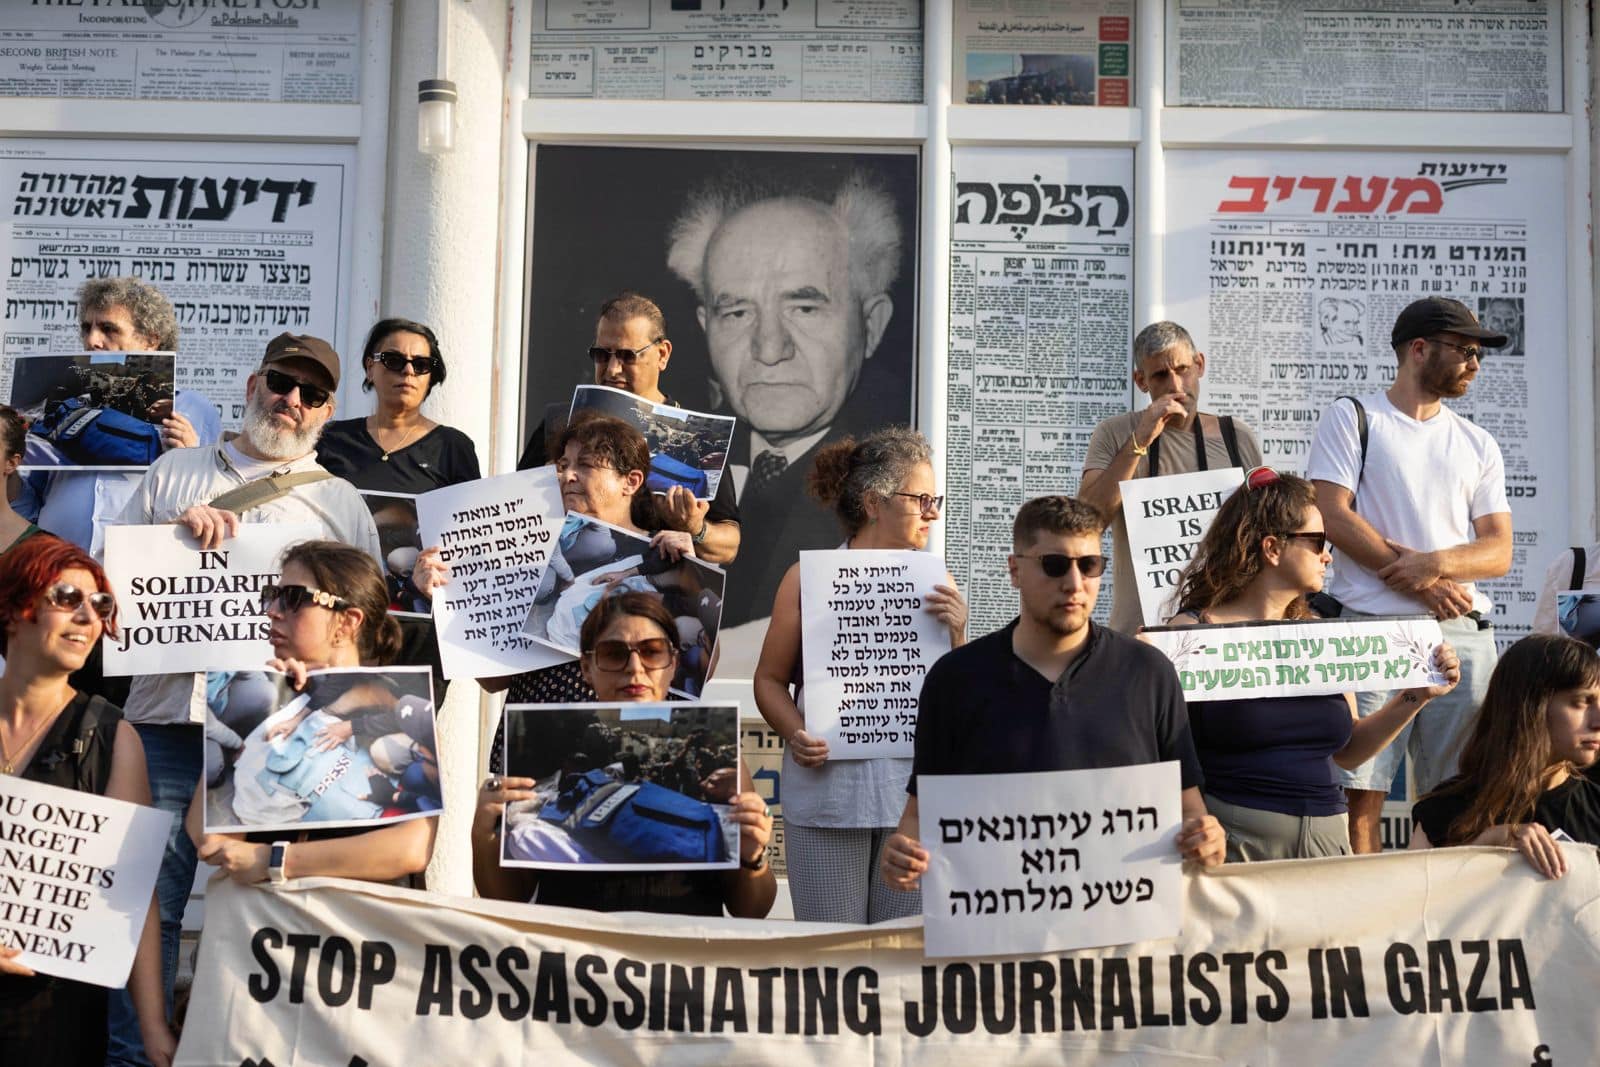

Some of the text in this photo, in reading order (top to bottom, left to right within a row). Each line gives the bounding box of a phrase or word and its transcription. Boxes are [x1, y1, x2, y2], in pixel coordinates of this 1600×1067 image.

[1353, 15, 1391, 29] העליה
[1447, 18, 1465, 30] את
[1469, 18, 1505, 30] אשרה
[1509, 18, 1548, 30] הכנסת
[46, 48, 86, 58] BRITISH
[89, 48, 119, 58] NOTE
[693, 45, 773, 62] מברקים
[1417, 161, 1508, 178] ידיעות
[20, 171, 127, 195] מהדורה
[123, 174, 318, 224] ידיעות
[1217, 175, 1444, 215] מעריב
[13, 195, 120, 219] ראשונה
[1210, 239, 1527, 262] המנדט מת! תחי מדינתנו!
[11, 256, 70, 279] גשרים
[131, 259, 176, 281] בתים
[186, 261, 249, 283] עשרות
[259, 263, 312, 284] פוצצו
[1209, 258, 1367, 275] ממשלת מדינת ישראל
[1371, 263, 1419, 277] האחרון
[1487, 264, 1527, 279] הנציב
[1209, 275, 1260, 290] השלטון
[1282, 275, 1315, 290] לידה
[1320, 275, 1367, 291] מקבלת
[1371, 278, 1409, 293] הארץ
[1470, 280, 1490, 295] את
[200, 303, 250, 325] מוכנה
[254, 305, 311, 327] הועדה
[1353, 363, 1368, 380] על
[452, 504, 501, 524] צוואתי
[1142, 491, 1223, 518] ISRAEL
[440, 514, 543, 547] והמסר האחרון
[1179, 517, 1202, 538] IS
[439, 530, 551, 562] שלי. אם המילים
[1144, 542, 1199, 566] TRY
[199, 551, 229, 570] IN
[451, 549, 546, 578] האלה מגיעות
[462, 567, 540, 593] אליכם, דעו
[838, 565, 908, 579] "חייתי את
[131, 574, 281, 596] SOLIDARIT
[833, 581, 915, 595] הכאב על כל
[136, 600, 213, 620] WITH
[444, 592, 502, 611] הצליחה
[828, 599, 921, 613] פרטיו, טעמתי
[468, 608, 503, 623] אותי
[838, 612, 912, 630] סבל ואובדן
[118, 622, 272, 652] JOURNALIS
[464, 627, 488, 641] את
[833, 631, 918, 646] פעמים רבות,
[831, 646, 921, 662] אך מעולם לא
[1223, 635, 1388, 663] מעצר עיתונאים
[827, 663, 926, 677] היססתי למסור
[1180, 655, 1412, 691] לא יסתיר את הפשעים
[843, 681, 911, 694] את האמת
[838, 698, 918, 713] כמות שהיא,
[840, 712, 916, 727] בלי עיוותים
[839, 730, 899, 744] סילופים"
[33, 803, 110, 834] ONLY
[939, 807, 1158, 844] הרג עיתונאים
[1021, 847, 1081, 875] הוא
[33, 881, 91, 911] THE
[949, 877, 1155, 916] פשע מלחמה
[49, 911, 75, 934] IS
[248, 926, 1537, 1038] STOP ASSASSINATING JOURNALISTS IN GAZA
